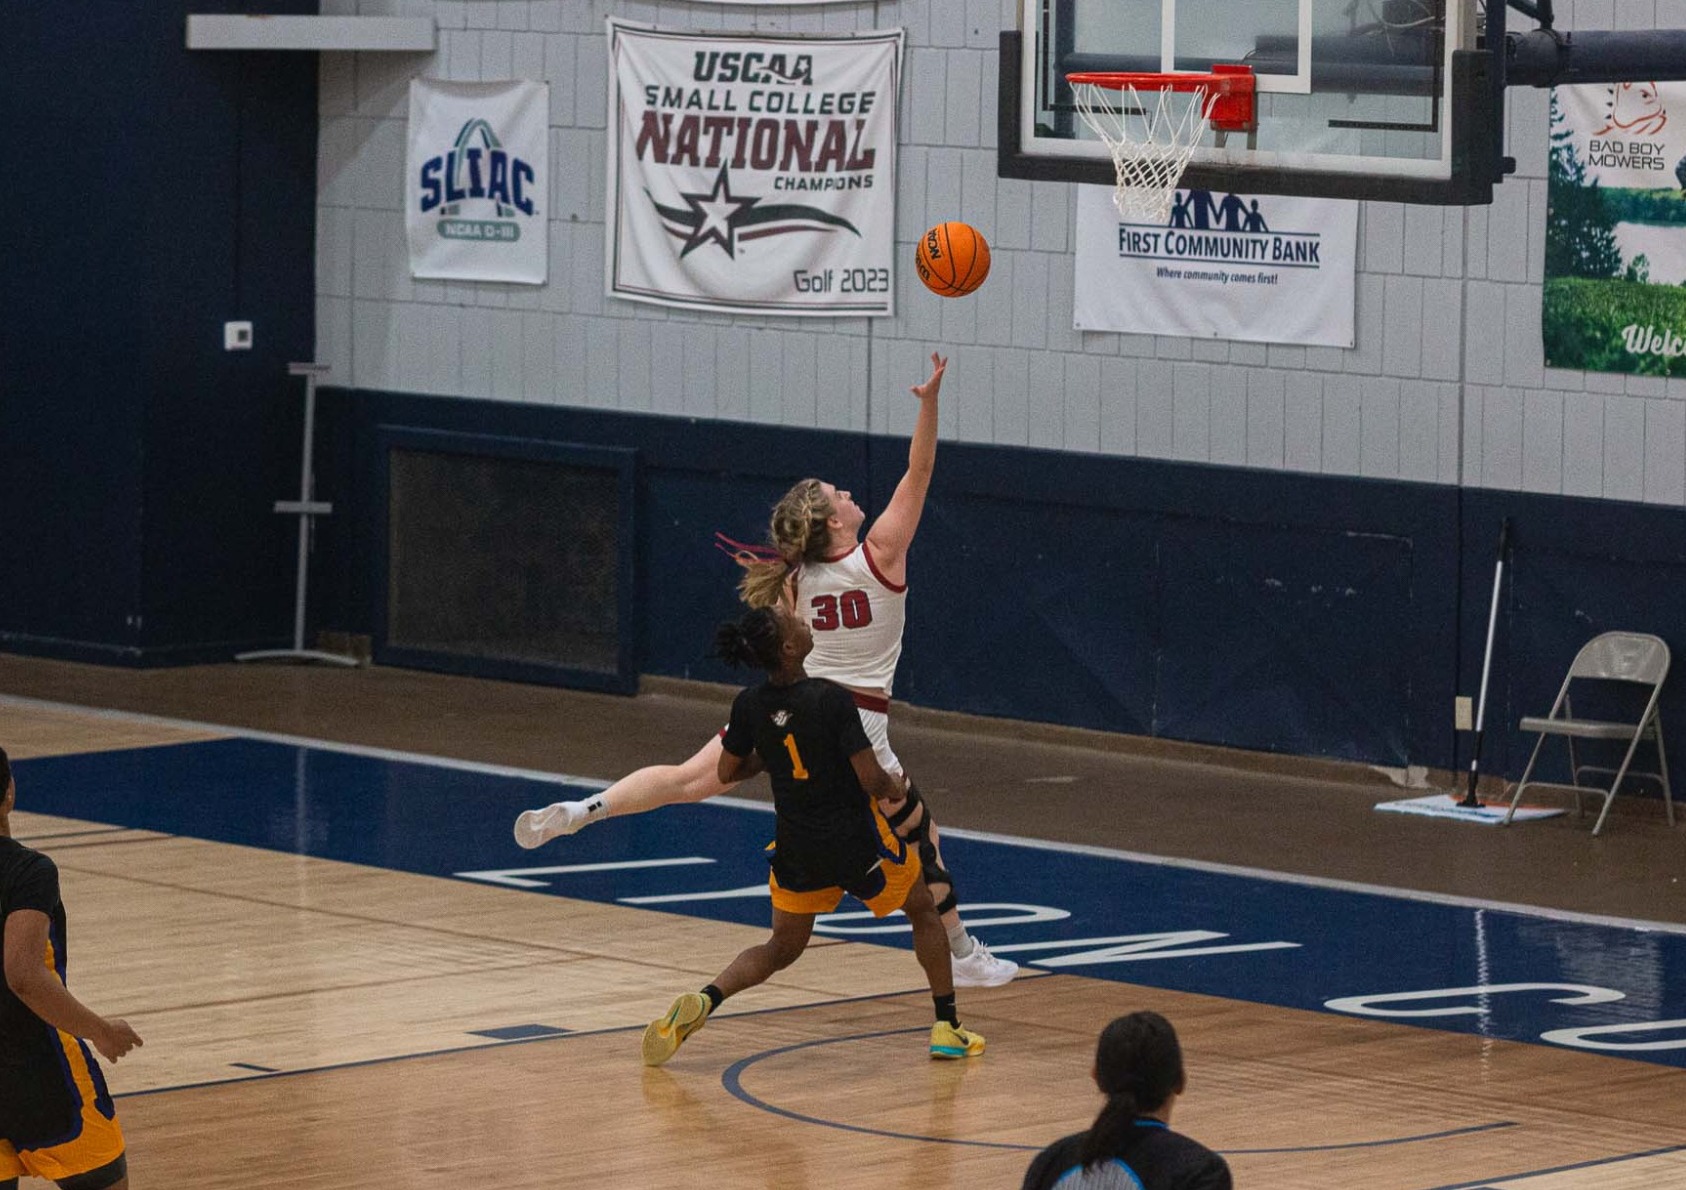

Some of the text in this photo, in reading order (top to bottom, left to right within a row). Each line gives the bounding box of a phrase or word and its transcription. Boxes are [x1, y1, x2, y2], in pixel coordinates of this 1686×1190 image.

[693, 51, 813, 86] USCAA
[645, 84, 876, 115] SMALL COLLEGE
[636, 110, 876, 172] NATIONAL
[1589, 140, 1665, 156] BAD BOY
[1588, 153, 1665, 171] MOWERS
[421, 148, 534, 216] SLIAC
[774, 174, 874, 192] CHAMPIONS
[446, 223, 482, 239] NCAA
[1119, 227, 1320, 263] FIRST COMMUNITY BANK
[793, 268, 889, 293] Golf 2023
[1156, 266, 1182, 279] Where
[1183, 268, 1229, 285] community
[1230, 272, 1256, 284] comes
[1621, 323, 1686, 357] Welc
[811, 589, 873, 632] 30
[783, 733, 809, 780] 1
